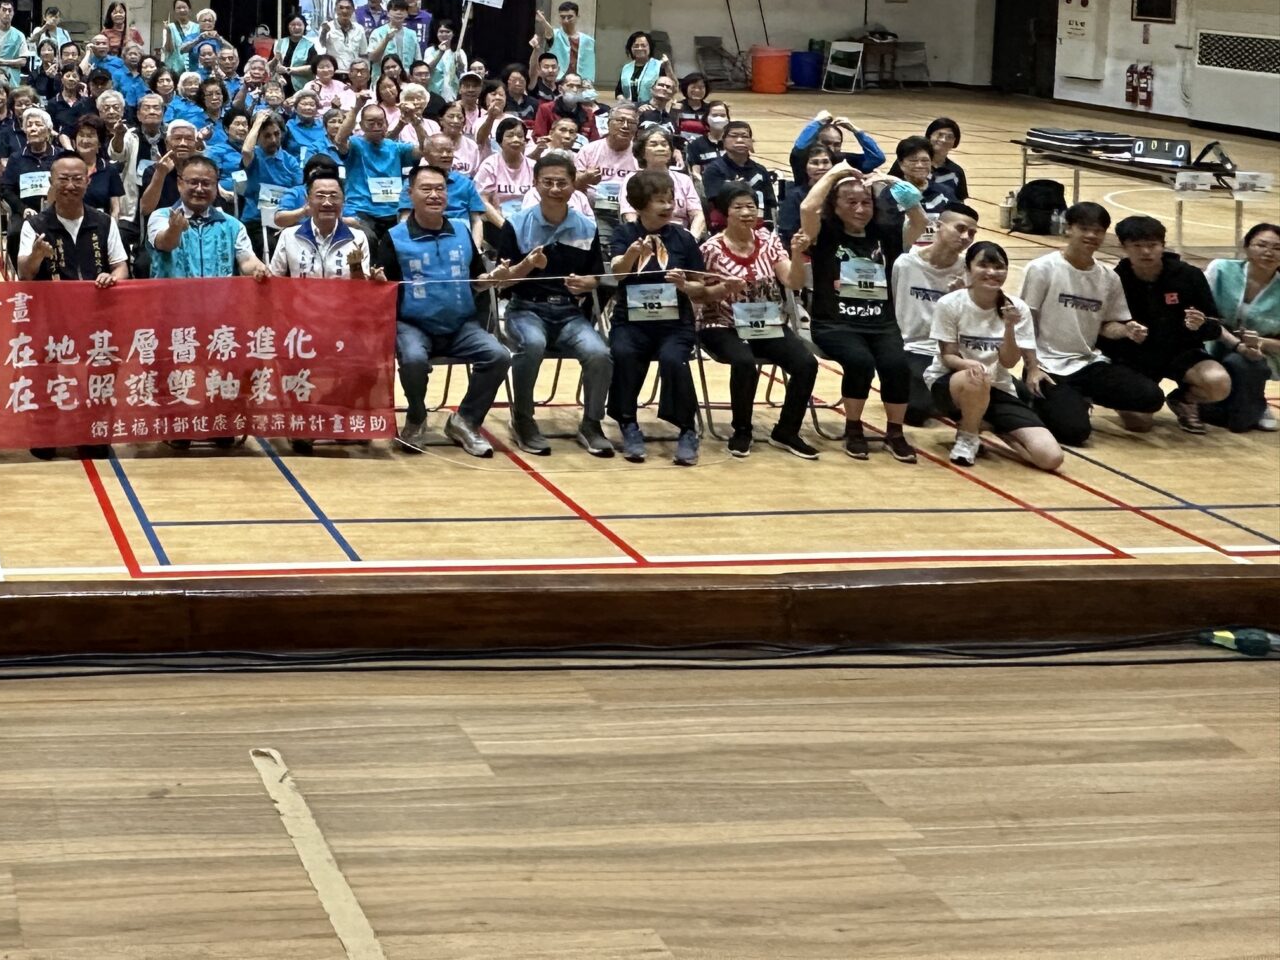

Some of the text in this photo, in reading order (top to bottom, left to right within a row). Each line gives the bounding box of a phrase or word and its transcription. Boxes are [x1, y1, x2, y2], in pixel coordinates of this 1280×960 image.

[1134, 141, 1144, 155] 0
[1175, 144, 1185, 158] 0
[497, 184, 516, 194] LIU
